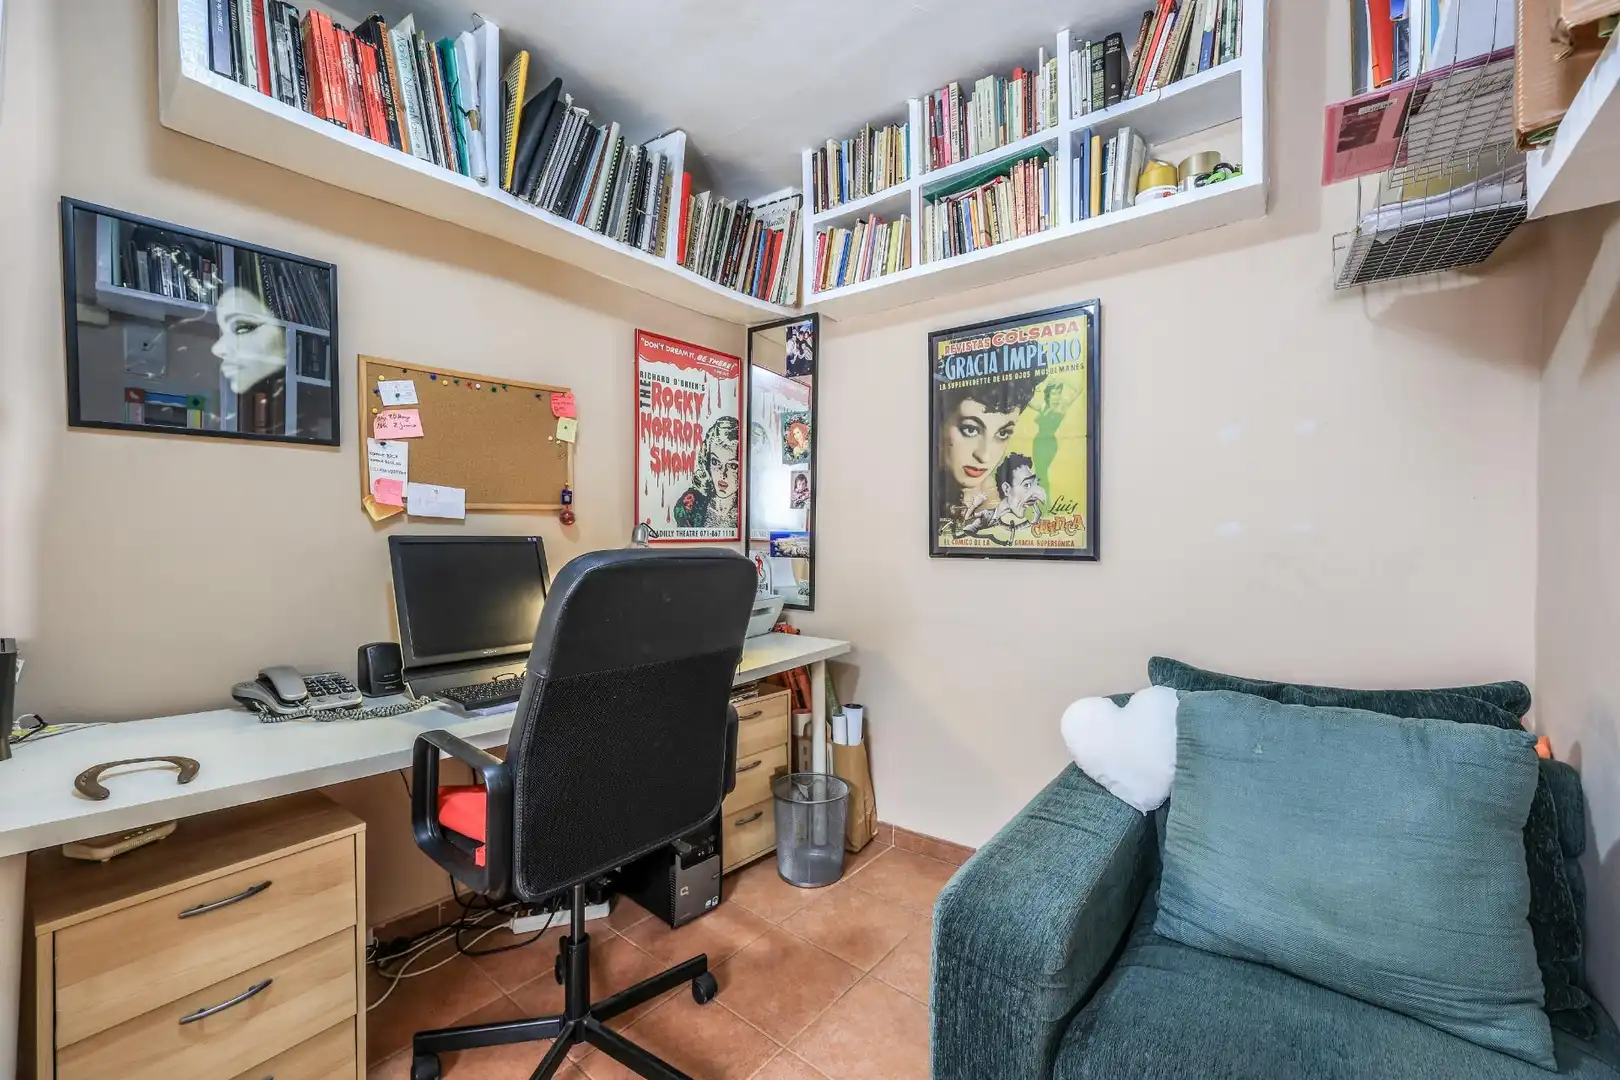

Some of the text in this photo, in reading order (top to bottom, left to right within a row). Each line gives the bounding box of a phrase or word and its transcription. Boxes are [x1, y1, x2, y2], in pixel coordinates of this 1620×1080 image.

[943, 320, 1080, 356] REVISTAS COLSADA
[945, 351, 998, 380] GRACIA
[1003, 338, 1082, 372] IMPERIO
[639, 371, 670, 384] RICHARD
[1002, 373, 1013, 381] LOS
[1014, 371, 1031, 380] OJOS
[639, 380, 651, 408] THE
[651, 381, 706, 419] ROCKY
[640, 411, 704, 449] HORROR
[650, 446, 697, 479] SHOW
[1048, 495, 1078, 515] Luis
